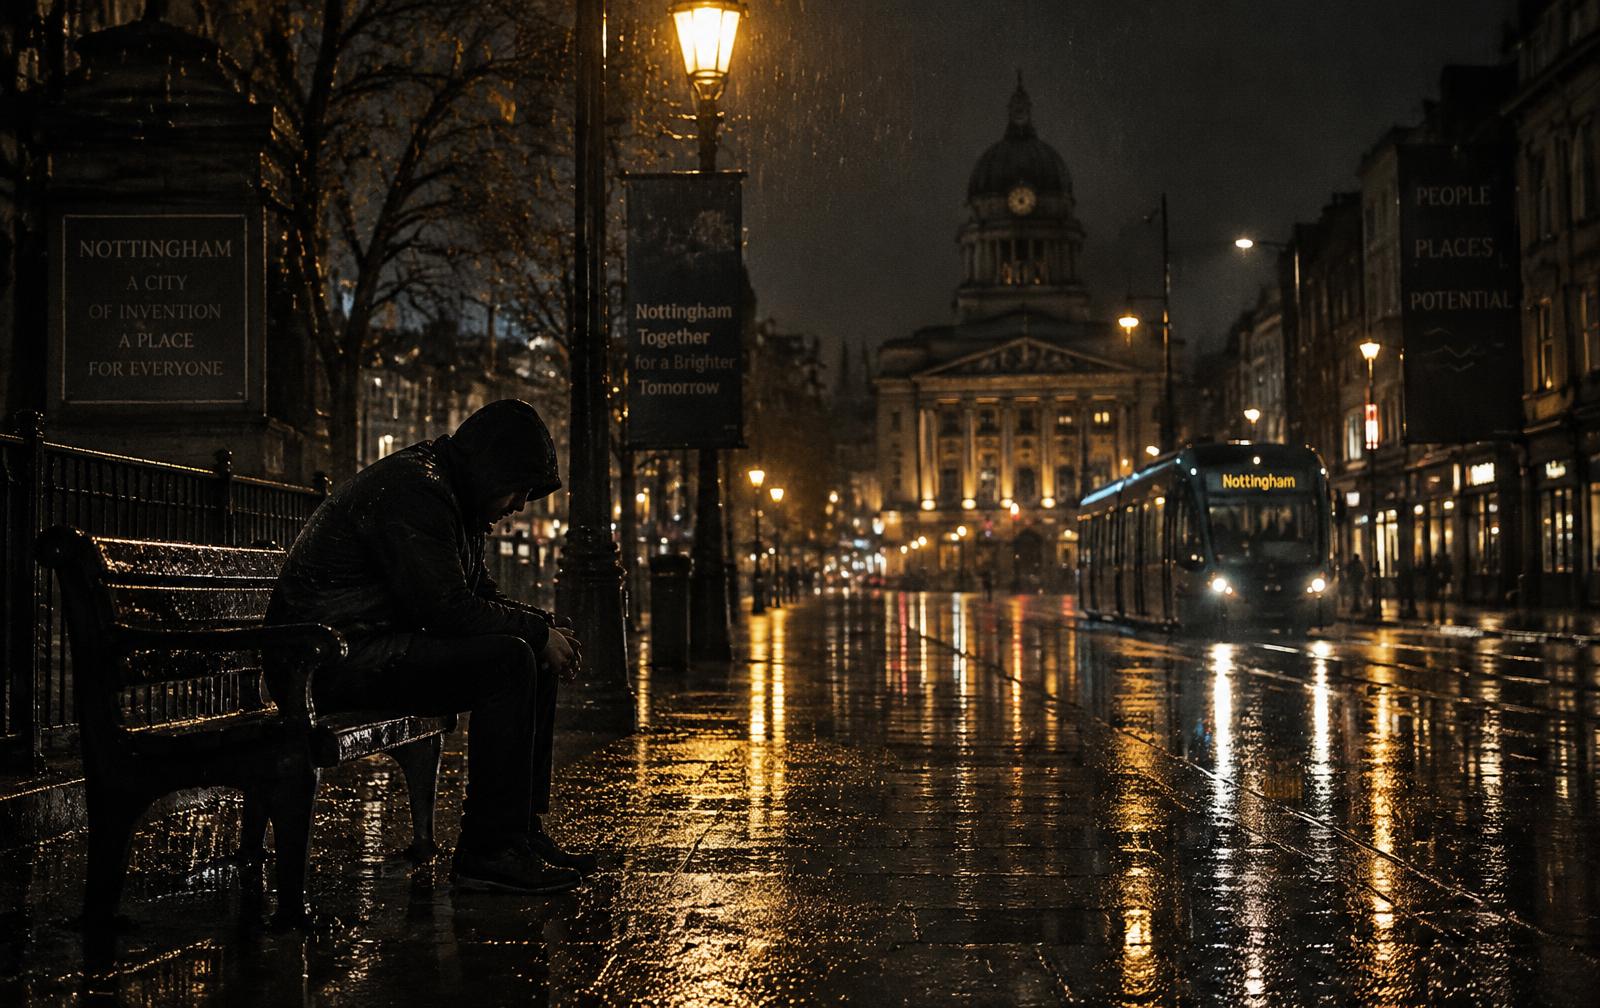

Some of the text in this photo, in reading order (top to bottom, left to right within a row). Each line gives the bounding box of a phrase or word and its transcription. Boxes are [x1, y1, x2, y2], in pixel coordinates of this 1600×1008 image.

[1416, 185, 1491, 206] PEOPLE
[79, 240, 232, 258] NOTTINGHAM
[1415, 237, 1494, 258] PLACES
[126, 275, 188, 290] A CITY
[1410, 289, 1515, 310] POTENTIAL
[88, 304, 222, 319] OF INVENTION
[635, 302, 733, 323] Nottingham
[118, 333, 194, 348] A PLACE
[637, 327, 711, 348] Together
[88, 361, 224, 376] FOR EVERYONE
[635, 354, 737, 373] for a Brighter
[638, 379, 720, 396] Tomorrow
[1222, 473, 1296, 491] Nottingham
